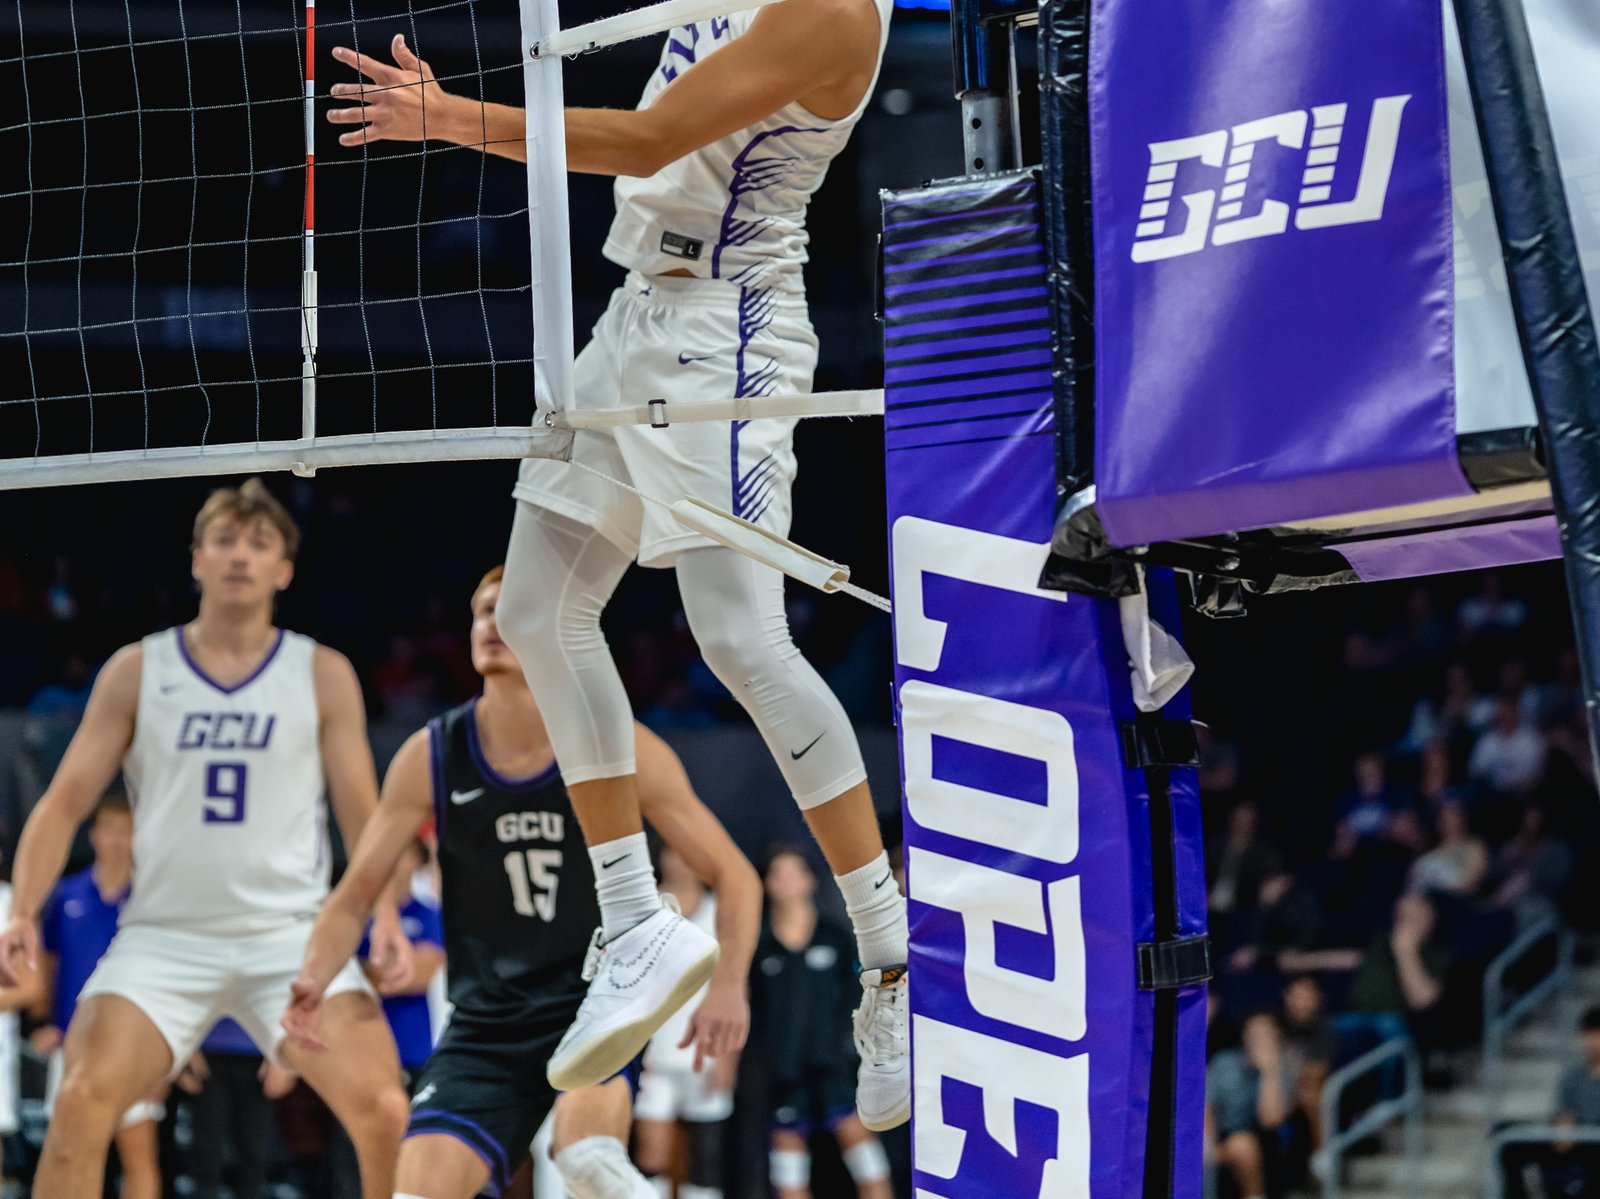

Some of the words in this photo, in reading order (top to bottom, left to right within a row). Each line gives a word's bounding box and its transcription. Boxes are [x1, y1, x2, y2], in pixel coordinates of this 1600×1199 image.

[1131, 93, 1413, 264] GCU
[177, 712, 276, 750] GCU
[203, 762, 248, 824] 9
[495, 811, 565, 843] GCU
[503, 848, 563, 923] 15
[892, 514, 1092, 1199] LOPE
